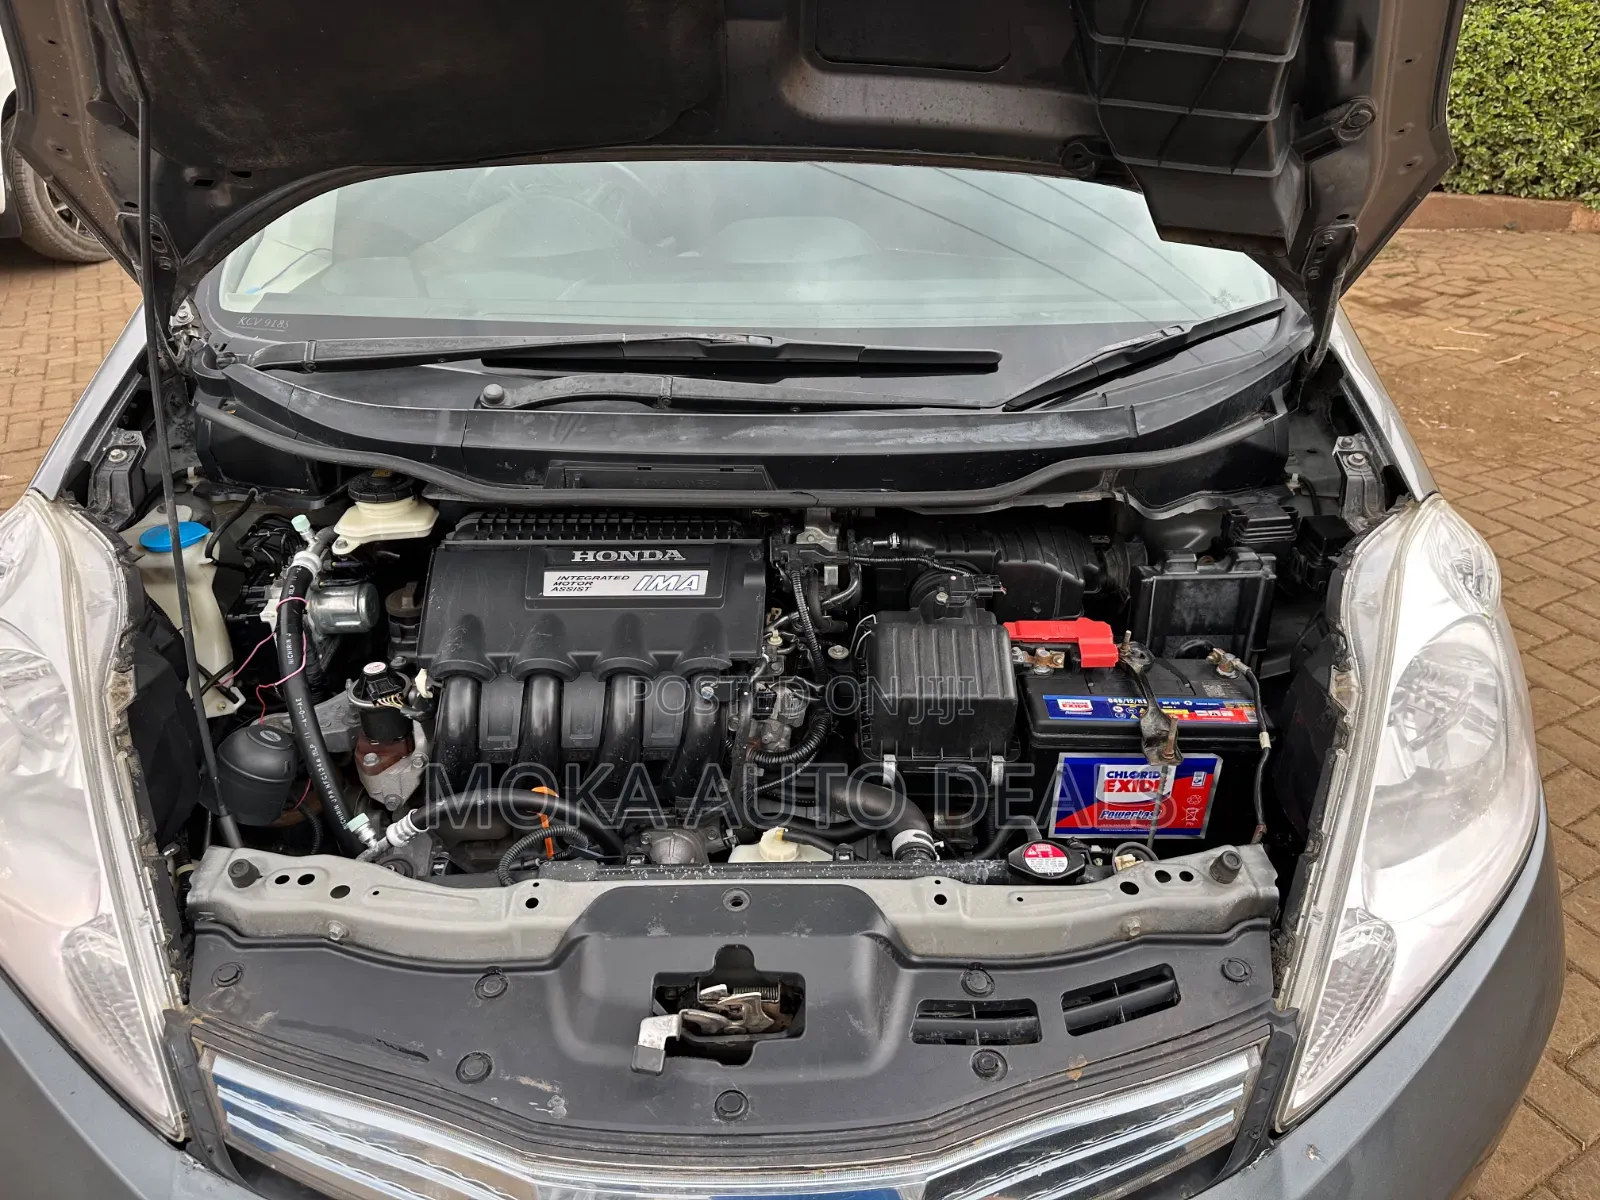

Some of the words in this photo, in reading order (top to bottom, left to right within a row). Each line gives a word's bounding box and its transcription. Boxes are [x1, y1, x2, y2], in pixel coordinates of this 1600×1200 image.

[571, 549, 686, 562] HONDA
[633, 574, 700, 591] IMA
[285, 639, 295, 665] NICHIRIN
[1106, 770, 1161, 779] CHLORID
